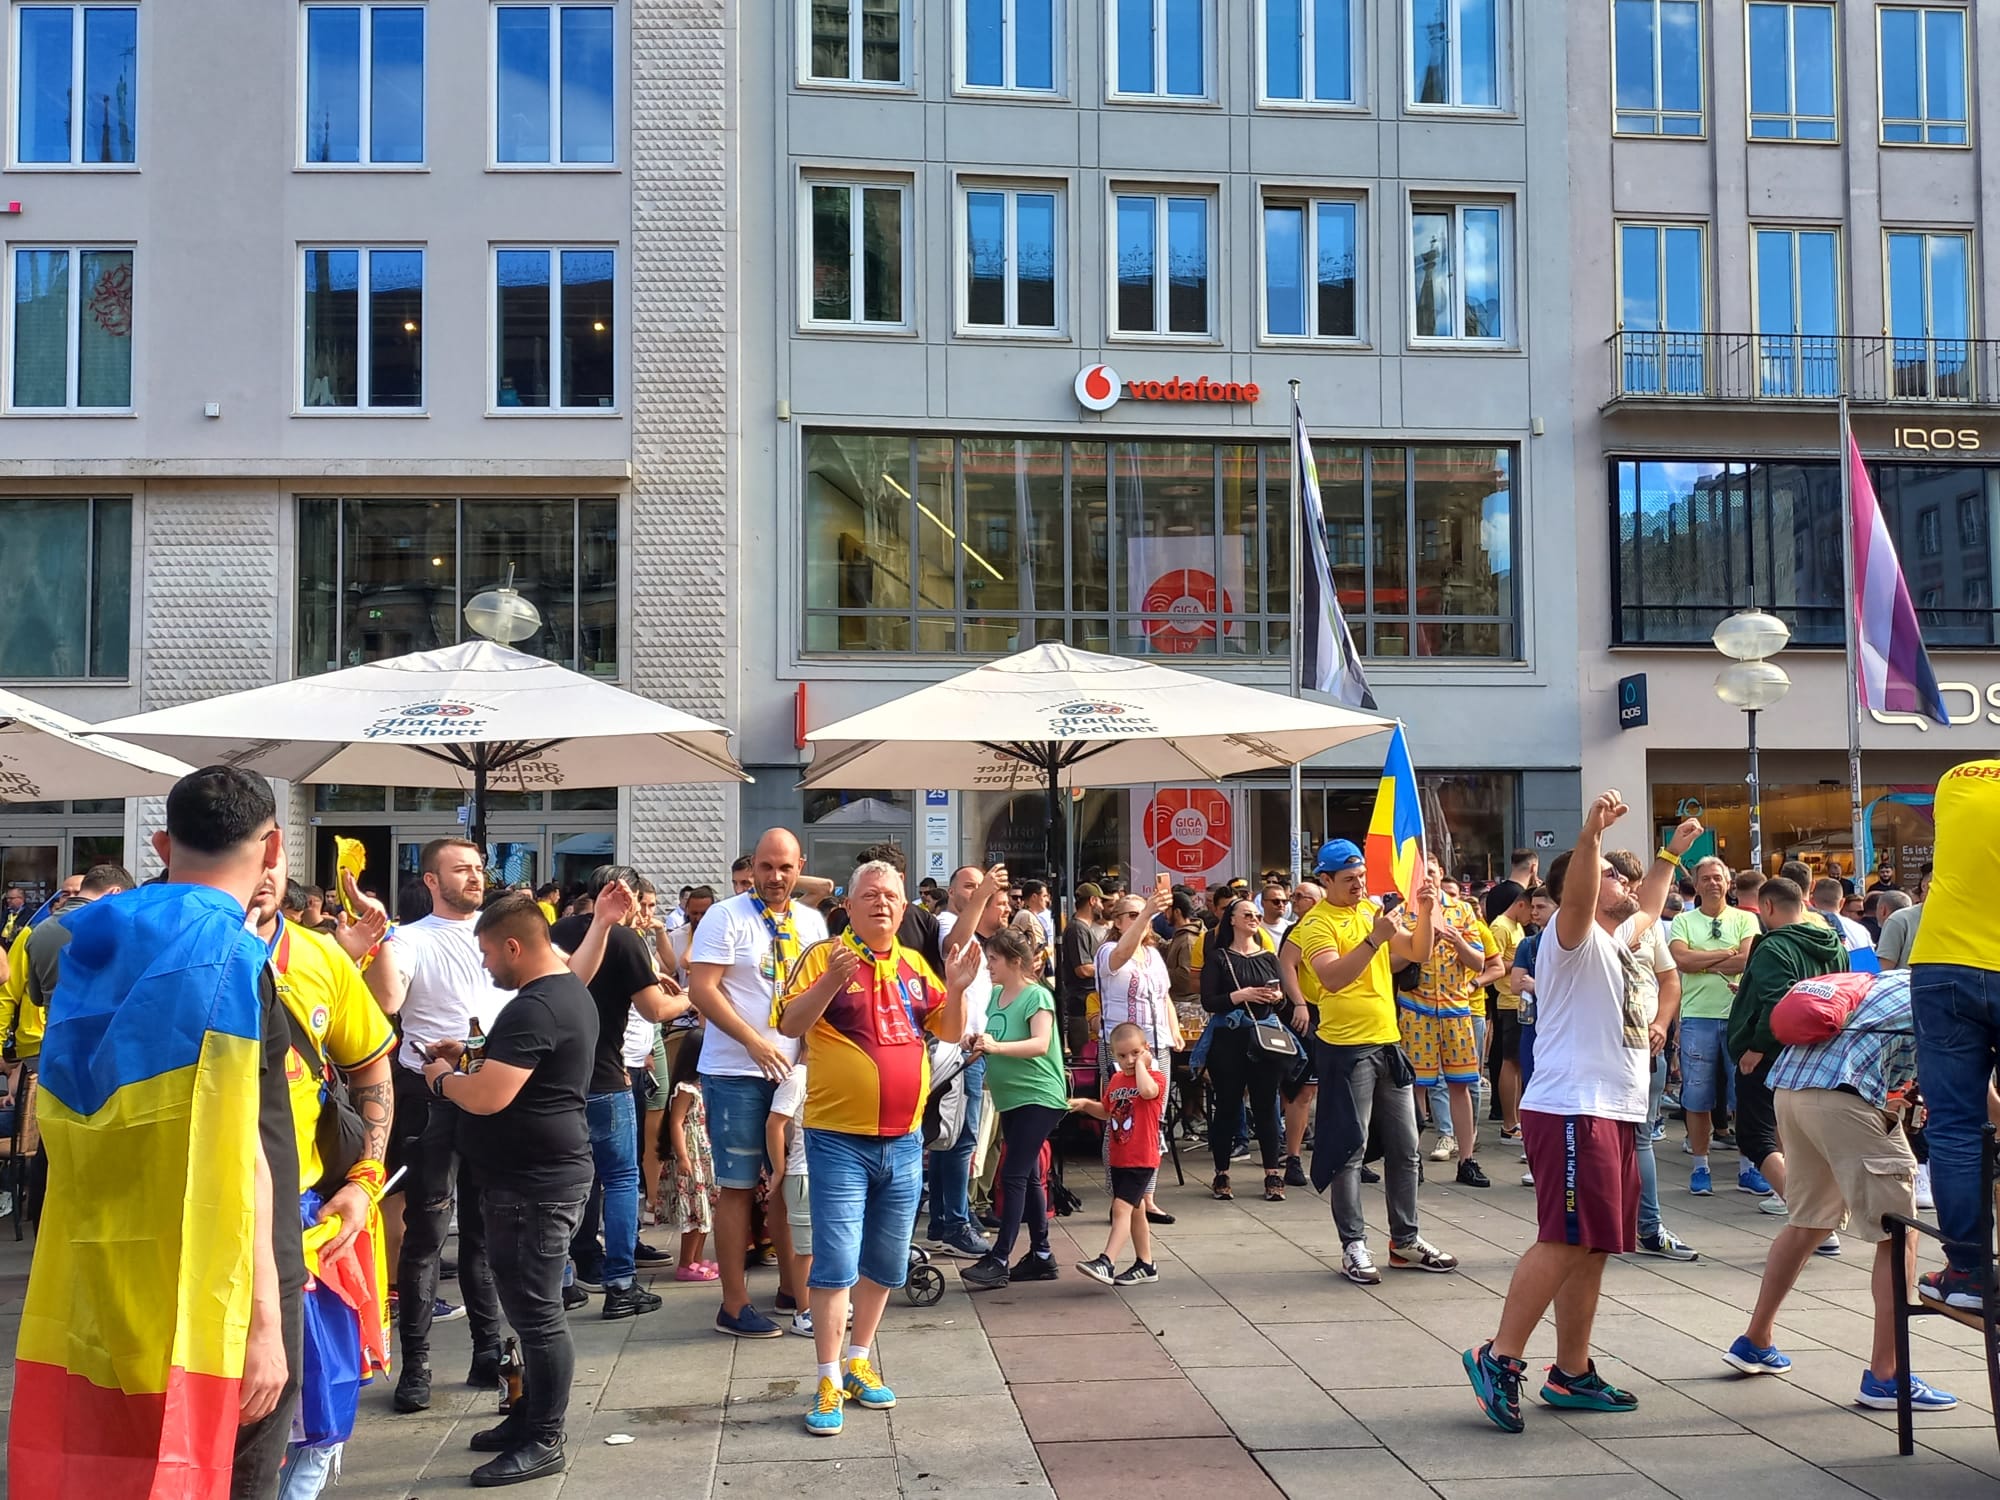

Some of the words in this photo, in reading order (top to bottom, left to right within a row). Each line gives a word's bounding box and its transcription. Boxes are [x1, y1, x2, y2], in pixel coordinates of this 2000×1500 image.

[1126, 376, 1260, 402] vodafone
[1894, 428, 1980, 452] IQOS
[1173, 605, 1199, 614] GIGA
[1182, 641, 1193, 649] TV
[1622, 706, 1641, 720] IQOS
[372, 717, 488, 729] Hacker
[1048, 715, 1152, 727] Hacker
[363, 726, 484, 738] Pschorr
[1048, 724, 1160, 737] Pschorr
[928, 789, 946, 799] 25
[1176, 817, 1202, 827] GIGA
[1176, 828, 1203, 836] KOMBI
[1903, 845, 1914, 854] Es
[1184, 854, 1195, 862] TV
[1808, 987, 1831, 998] GOOD
[1566, 1122, 1576, 1157] LAUREN
[1566, 1160, 1576, 1188] RALPH
[1566, 1189, 1575, 1212] POLO
